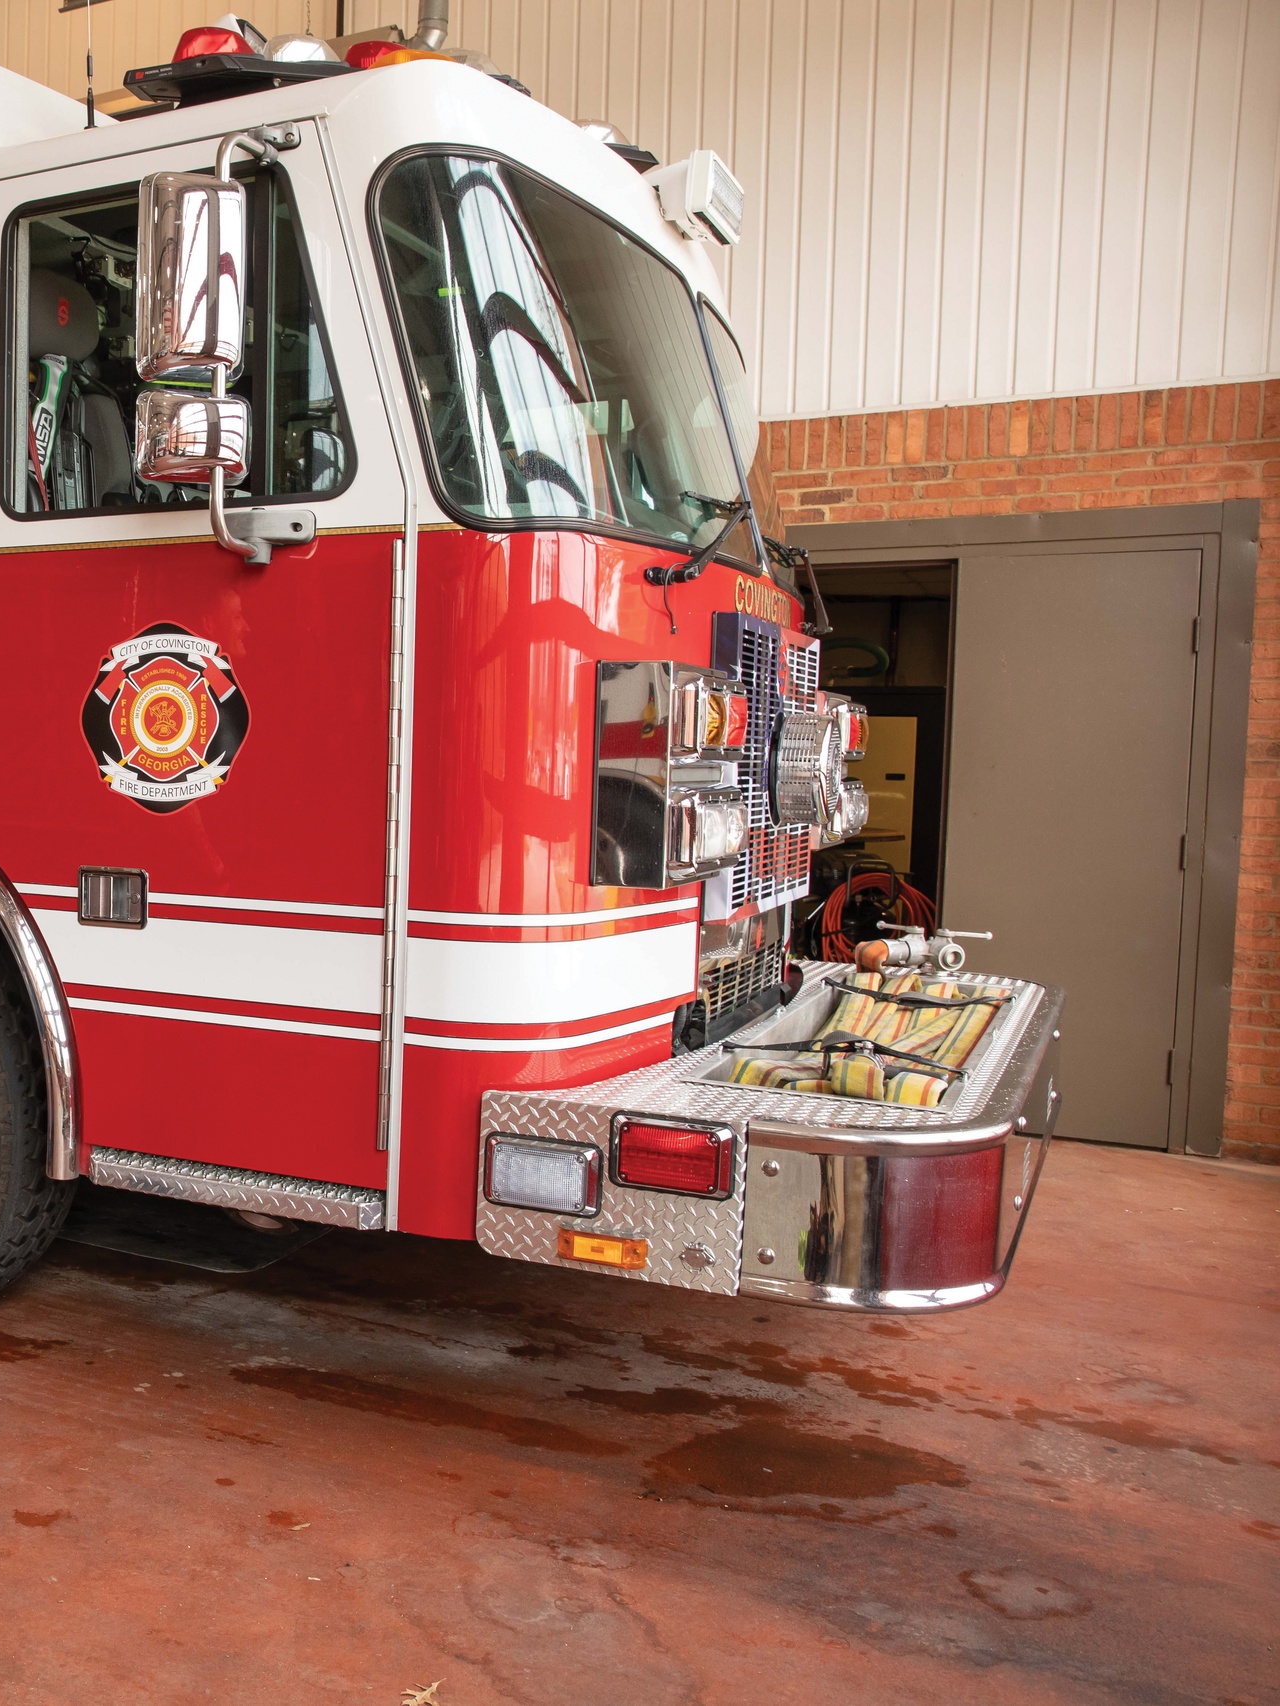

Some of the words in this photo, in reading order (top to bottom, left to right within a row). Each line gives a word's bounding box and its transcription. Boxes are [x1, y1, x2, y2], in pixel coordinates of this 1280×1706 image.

[36, 413, 52, 462] MSA
[735, 574, 791, 630] COVINGTON
[119, 642, 140, 657] CITY
[141, 639, 154, 651] OF
[155, 638, 210, 654] COVINGTON
[137, 754, 191, 772] GEORGIA
[119, 778, 139, 795] FIRE
[141, 780, 209, 798] DEPARTMENT
